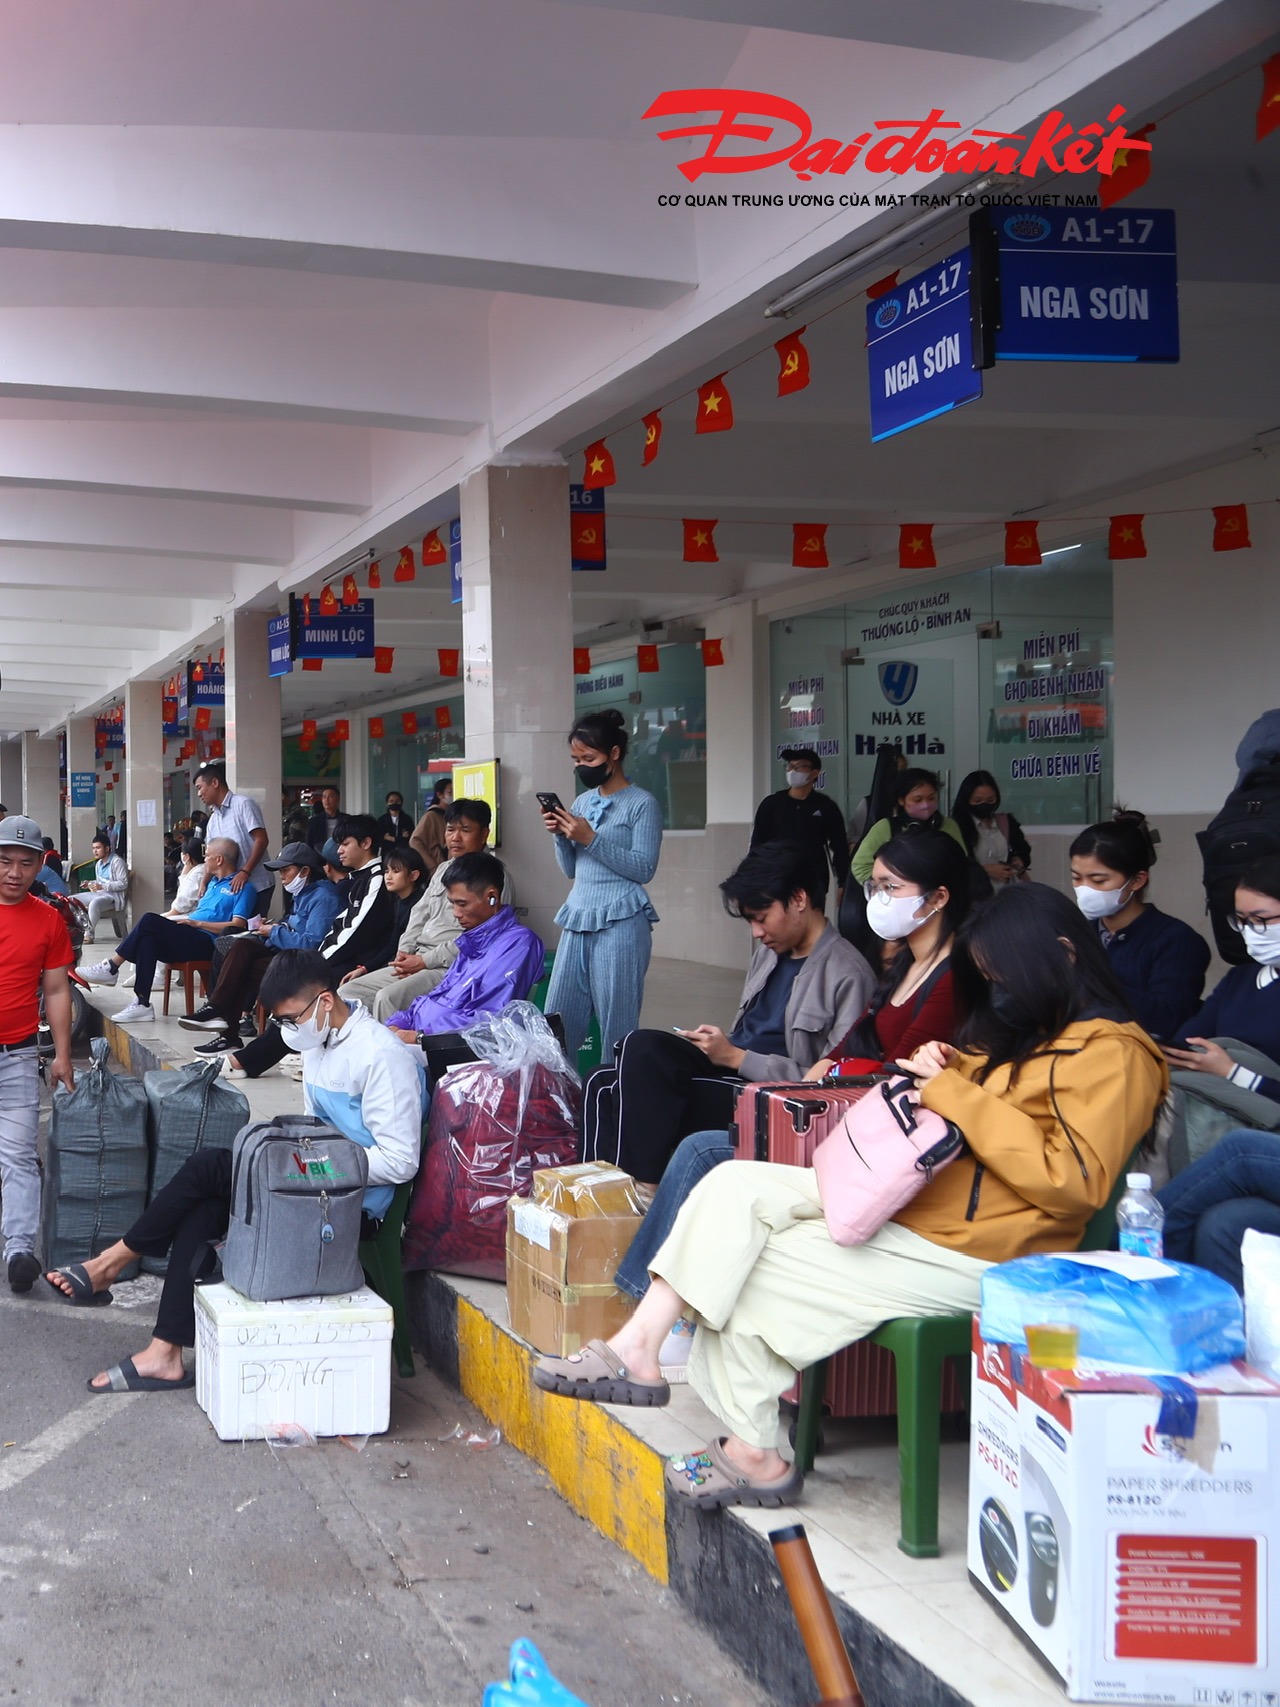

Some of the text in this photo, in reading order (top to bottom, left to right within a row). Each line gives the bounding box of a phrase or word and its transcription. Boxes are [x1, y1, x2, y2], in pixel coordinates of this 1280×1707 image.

[1061, 217, 1154, 243] A1-17
[906, 261, 962, 314] A1-17
[1020, 285, 1150, 320] NGA SƠN
[884, 333, 960, 398] NGA SƠN
[954, 608, 972, 625] AN
[305, 627, 365, 645] MINH LỘC
[1059, 627, 1081, 653] PHÍ
[1067, 666, 1104, 693] NHÂN
[872, 708, 926, 726] NHÀ XE
[1028, 709, 1080, 738] ĐI KHÁM
[906, 733, 945, 755] Hà
[1047, 752, 1080, 781] BỆNH
[1160, 1477, 1254, 1495] SHREDDERS
